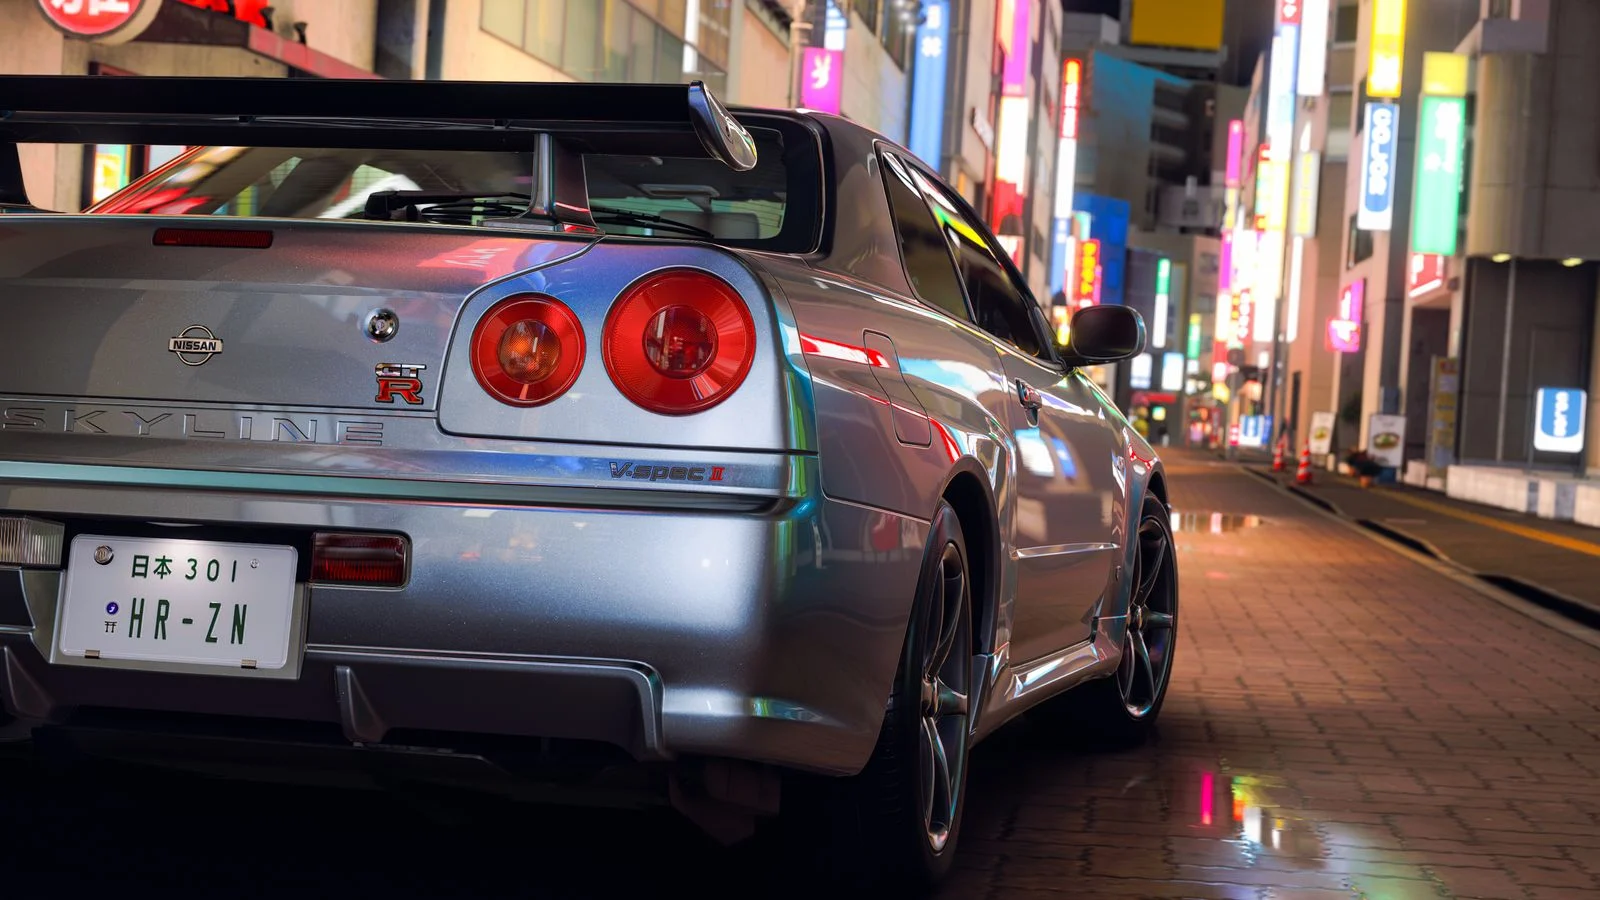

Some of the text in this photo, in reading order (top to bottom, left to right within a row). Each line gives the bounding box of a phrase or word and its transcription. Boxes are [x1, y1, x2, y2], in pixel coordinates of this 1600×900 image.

[172, 339, 218, 352] NISSAN
[374, 362, 427, 378] GT
[374, 377, 424, 405] R
[1, 406, 384, 447] SKYLINE
[130, 554, 238, 583] 日本 301
[128, 597, 248, 645] HR-ZN
